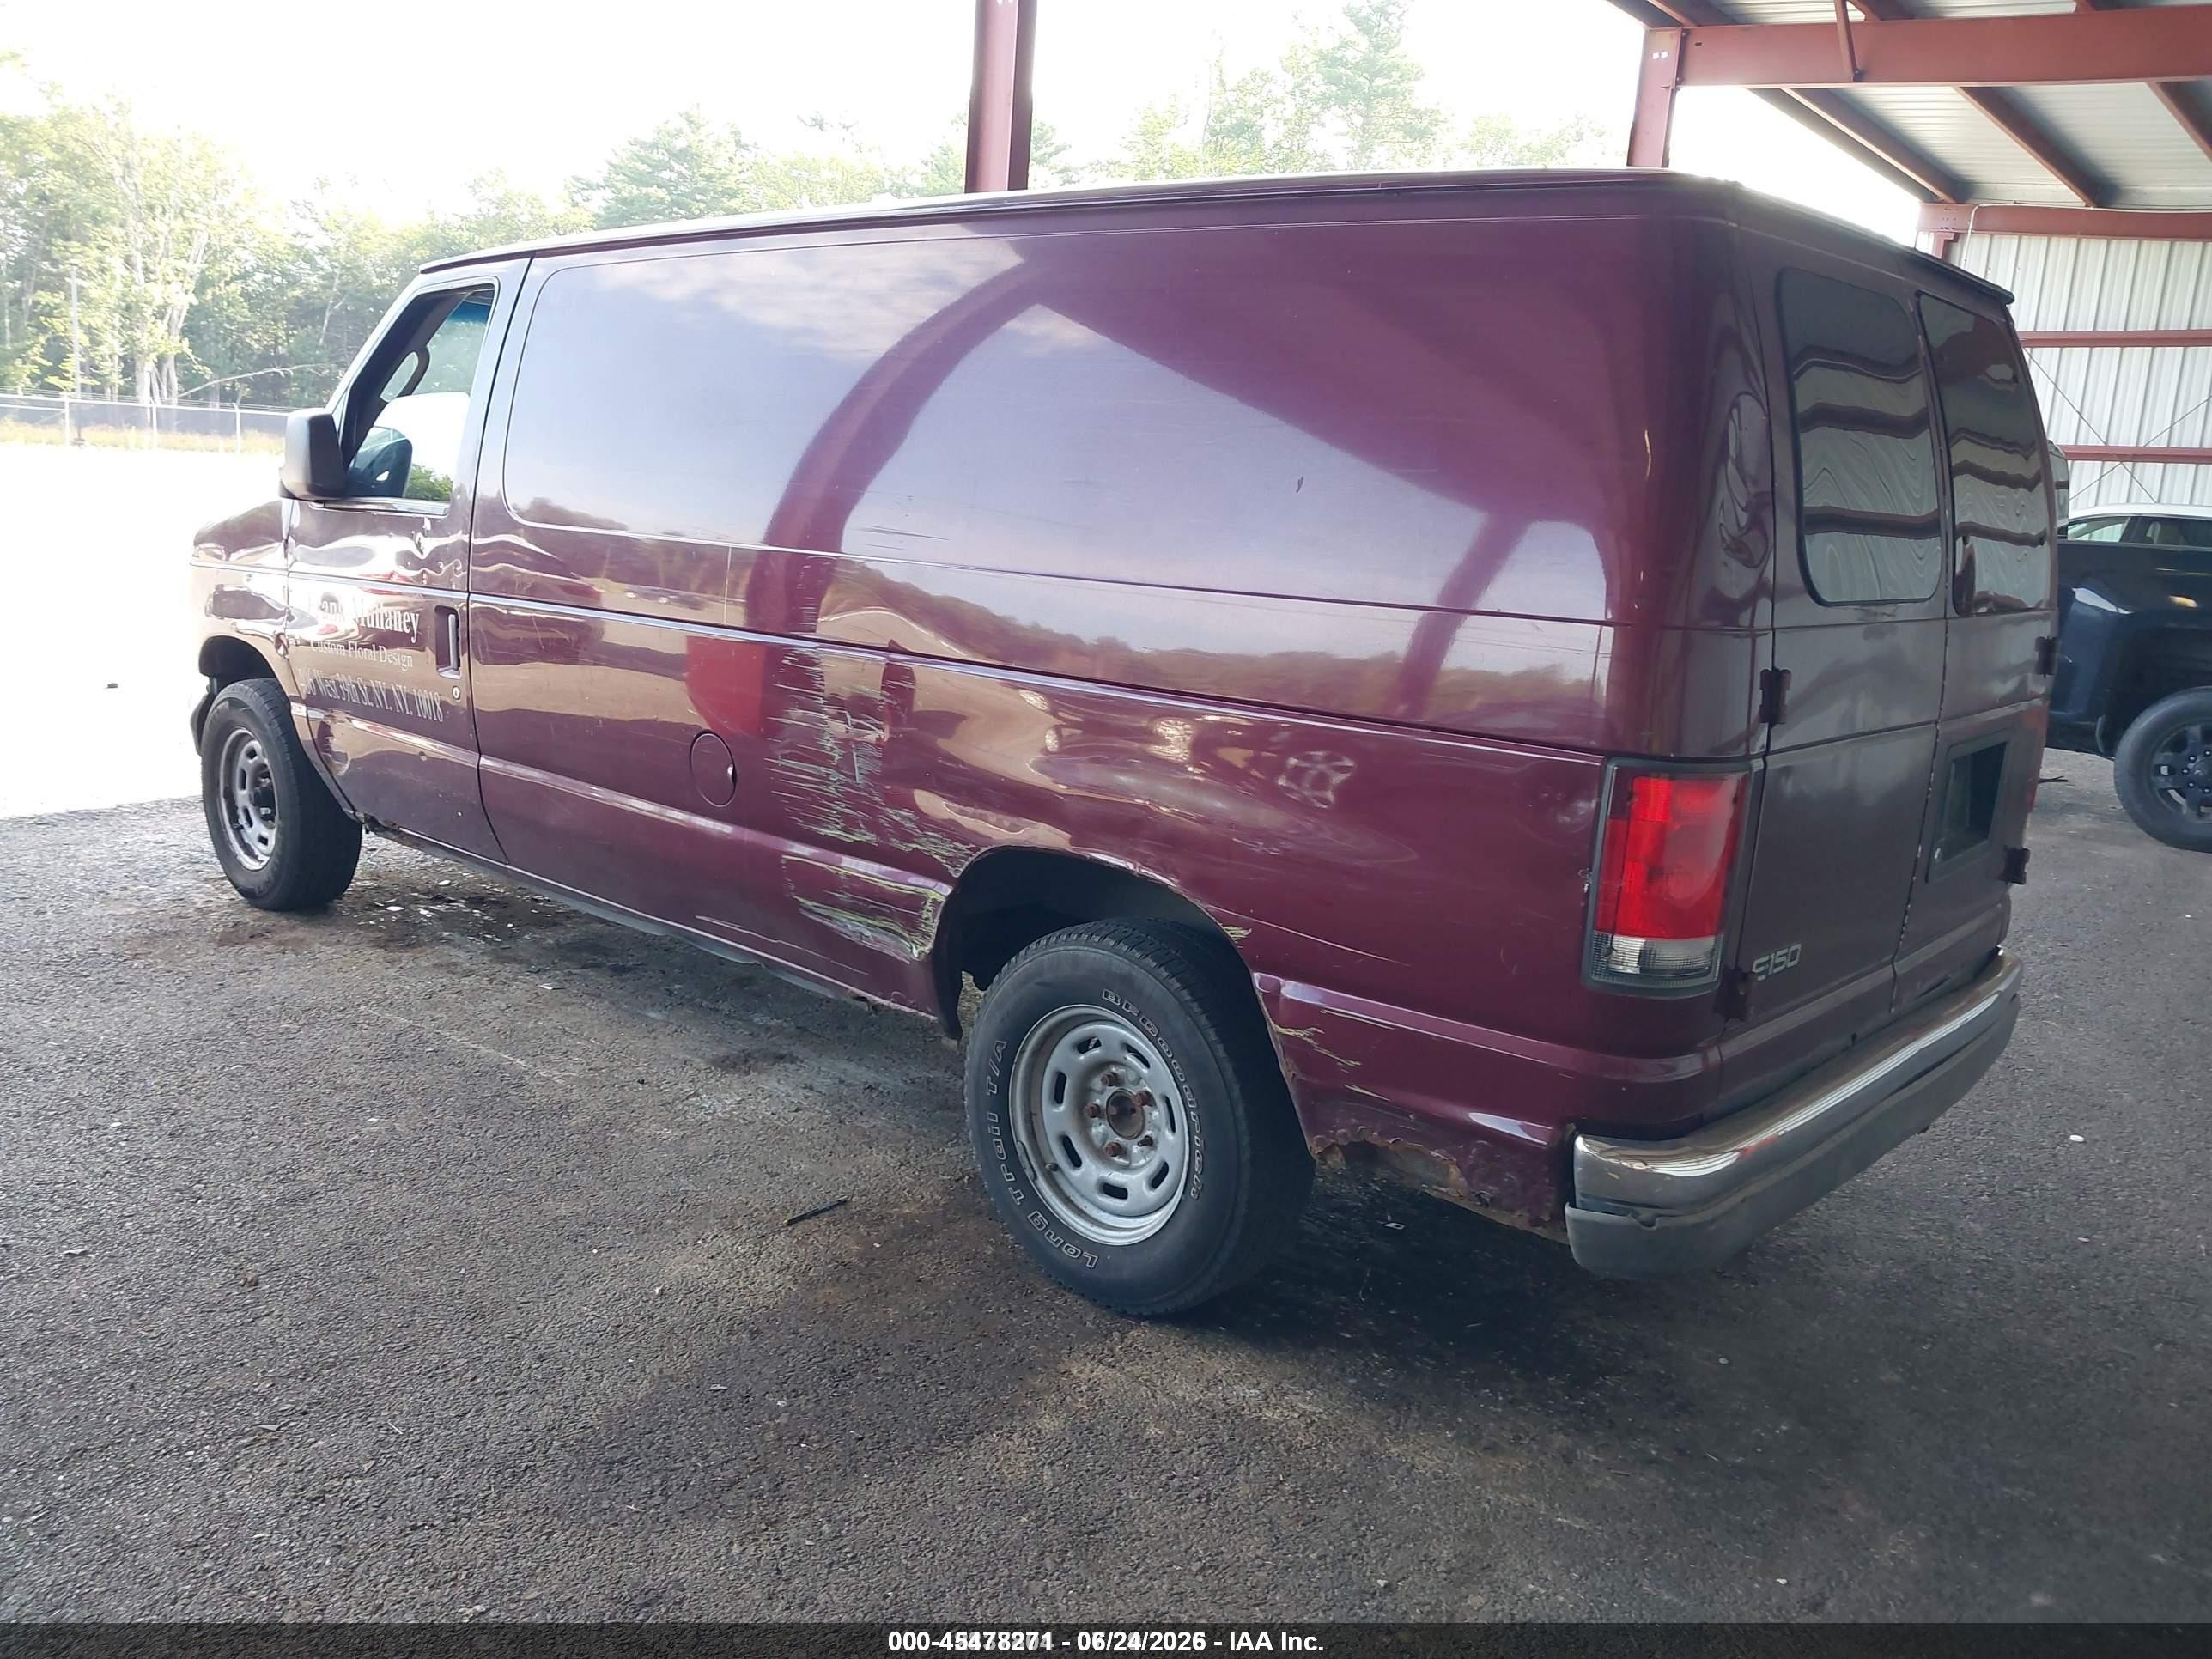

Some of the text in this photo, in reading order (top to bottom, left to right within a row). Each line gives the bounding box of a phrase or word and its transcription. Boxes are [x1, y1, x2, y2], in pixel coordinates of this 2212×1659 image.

[348, 641, 376, 661] Floral
[379, 645, 412, 672] Design
[313, 669, 340, 700] West
[413, 689, 443, 722] 10018
[1752, 944, 1802, 981] E150
[987, 1040, 1007, 1096] T/A
